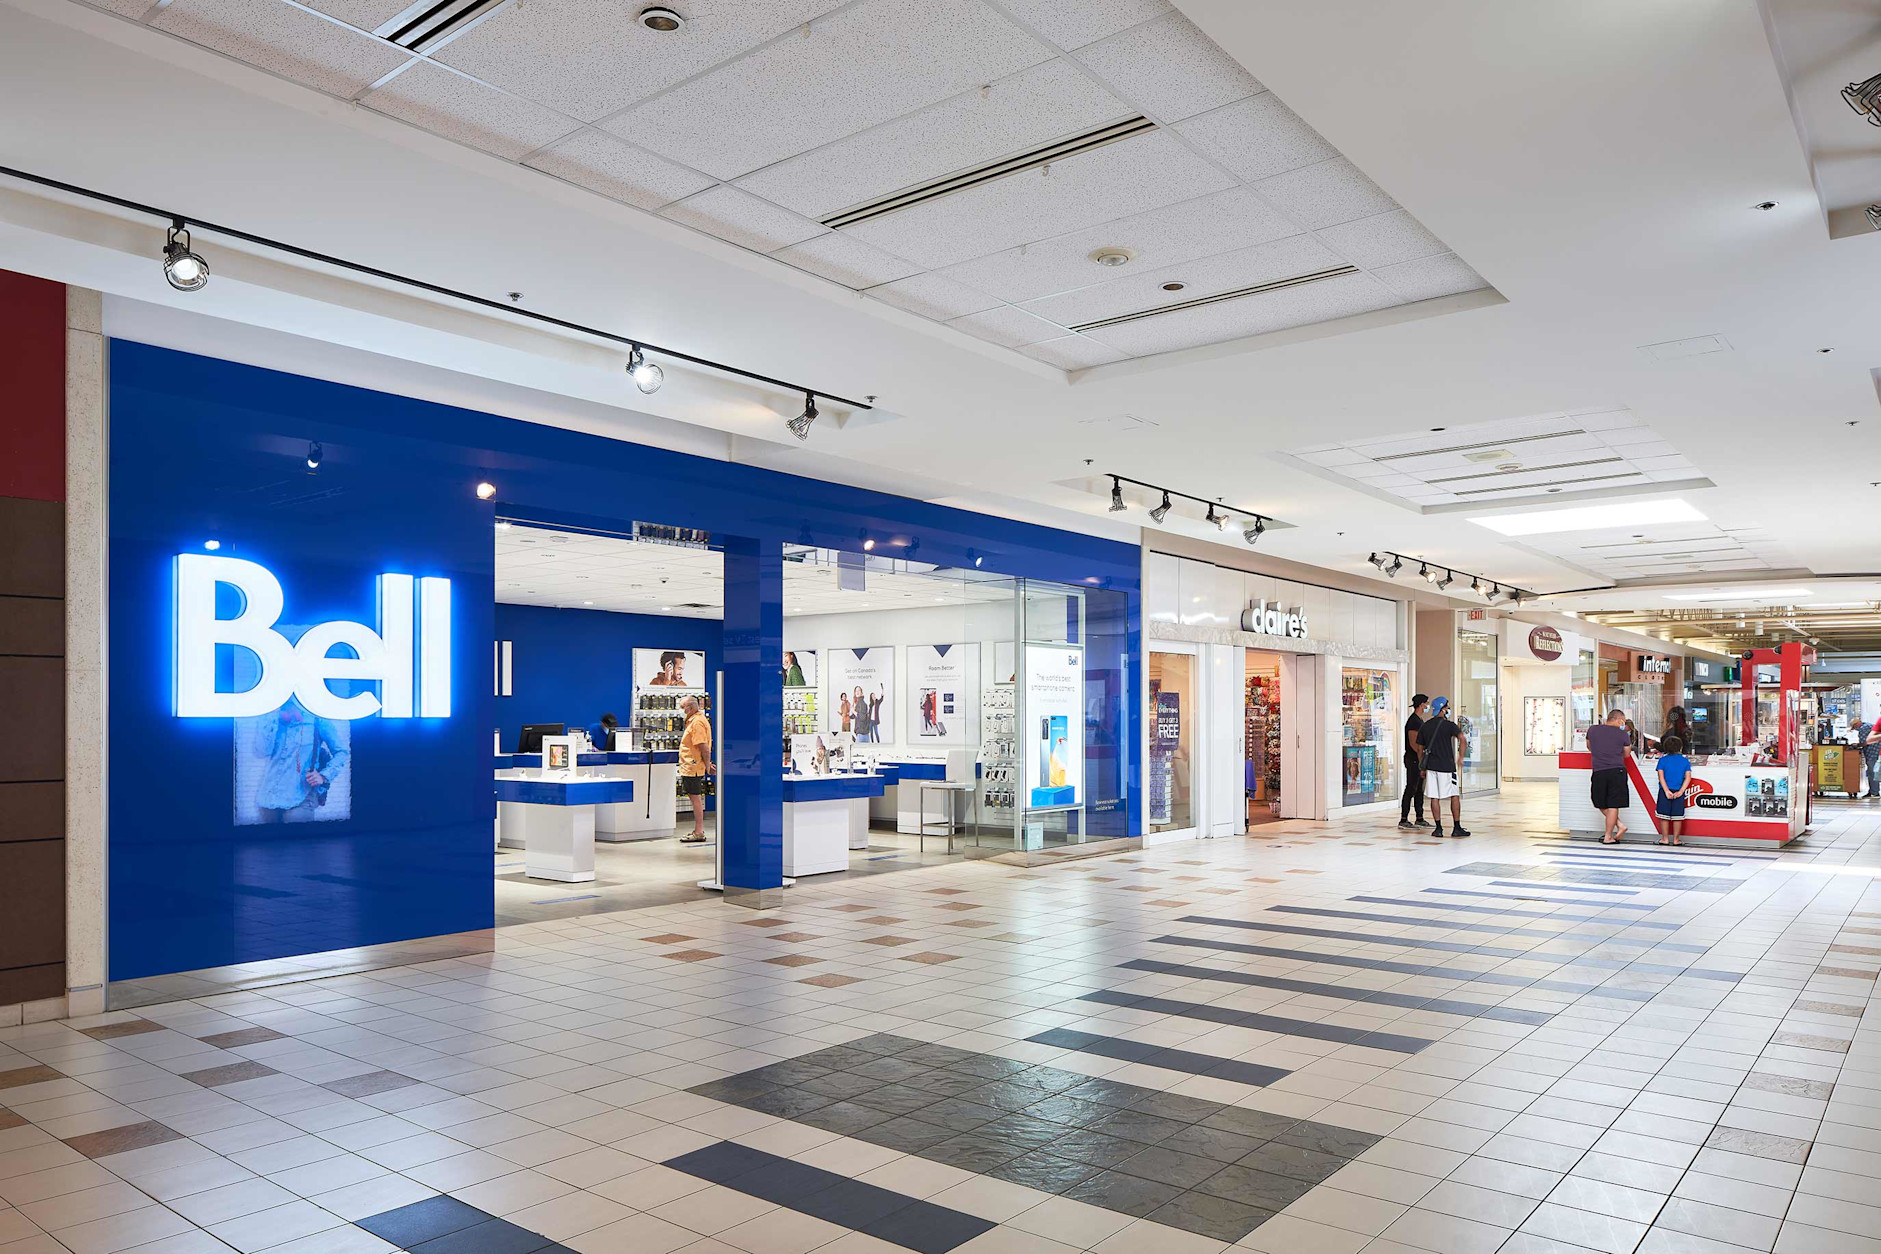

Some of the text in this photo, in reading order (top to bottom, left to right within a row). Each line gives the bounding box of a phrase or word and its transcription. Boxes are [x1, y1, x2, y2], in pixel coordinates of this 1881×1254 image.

[1250, 598, 1308, 638] claire's
[1470, 610, 1483, 620] EXIT
[171, 553, 451, 720] Bell
[1068, 655, 1079, 665] Bell
[1158, 724, 1179, 739] FREE
[1700, 798, 1733, 807] mobile
